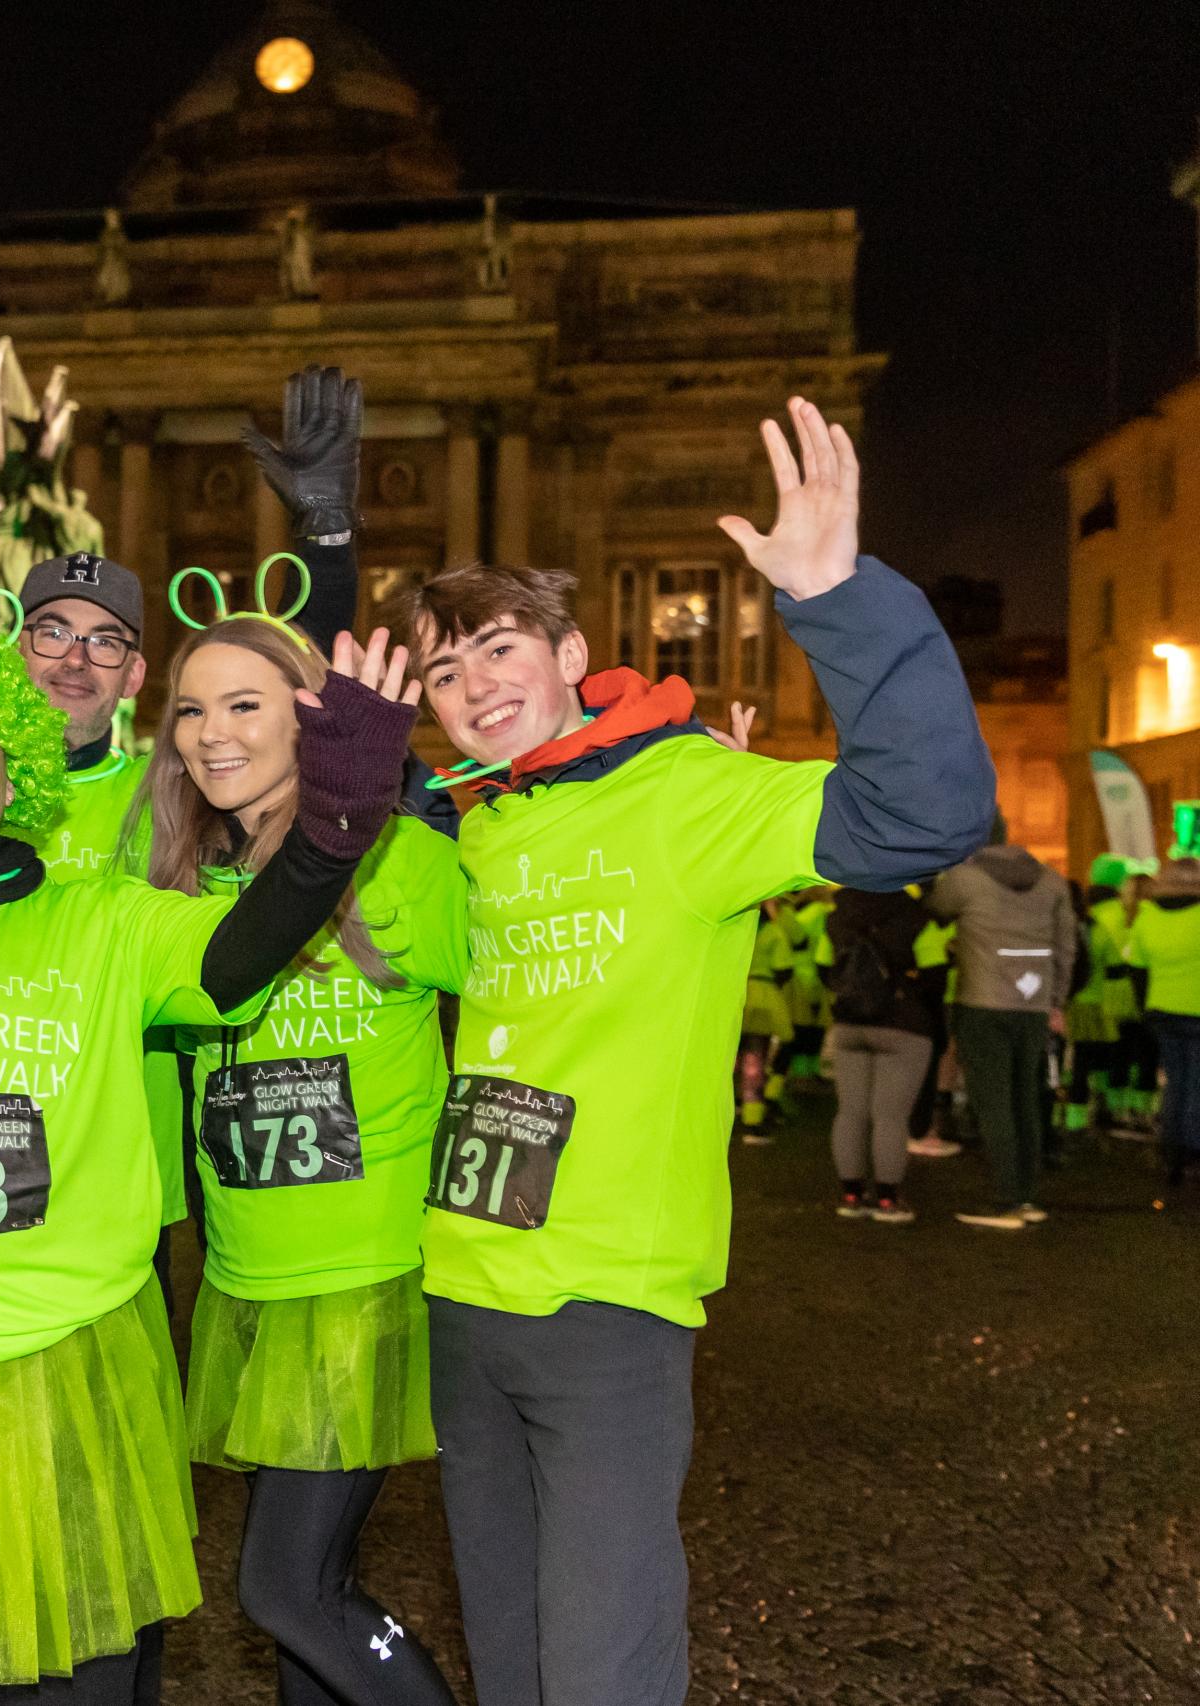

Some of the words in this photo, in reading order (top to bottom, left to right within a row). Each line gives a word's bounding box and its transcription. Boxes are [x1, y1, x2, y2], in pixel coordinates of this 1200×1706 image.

[60, 554, 102, 586] H
[468, 927, 500, 958] OW
[505, 908, 625, 955] GREEN
[465, 963, 516, 997] GHT
[524, 952, 612, 996] WALK
[270, 1009, 378, 1049] WALK
[254, 1084, 293, 1099] GLOW
[296, 1080, 340, 1095] GREEN
[257, 1096, 298, 1112] NIGHT
[302, 1094, 341, 1109] WALK
[473, 1102, 509, 1121] GLOW
[230, 1114, 324, 1182] 173
[473, 1117, 509, 1137] NIGHT
[511, 1125, 551, 1145] WALK
[437, 1133, 514, 1216] 131
